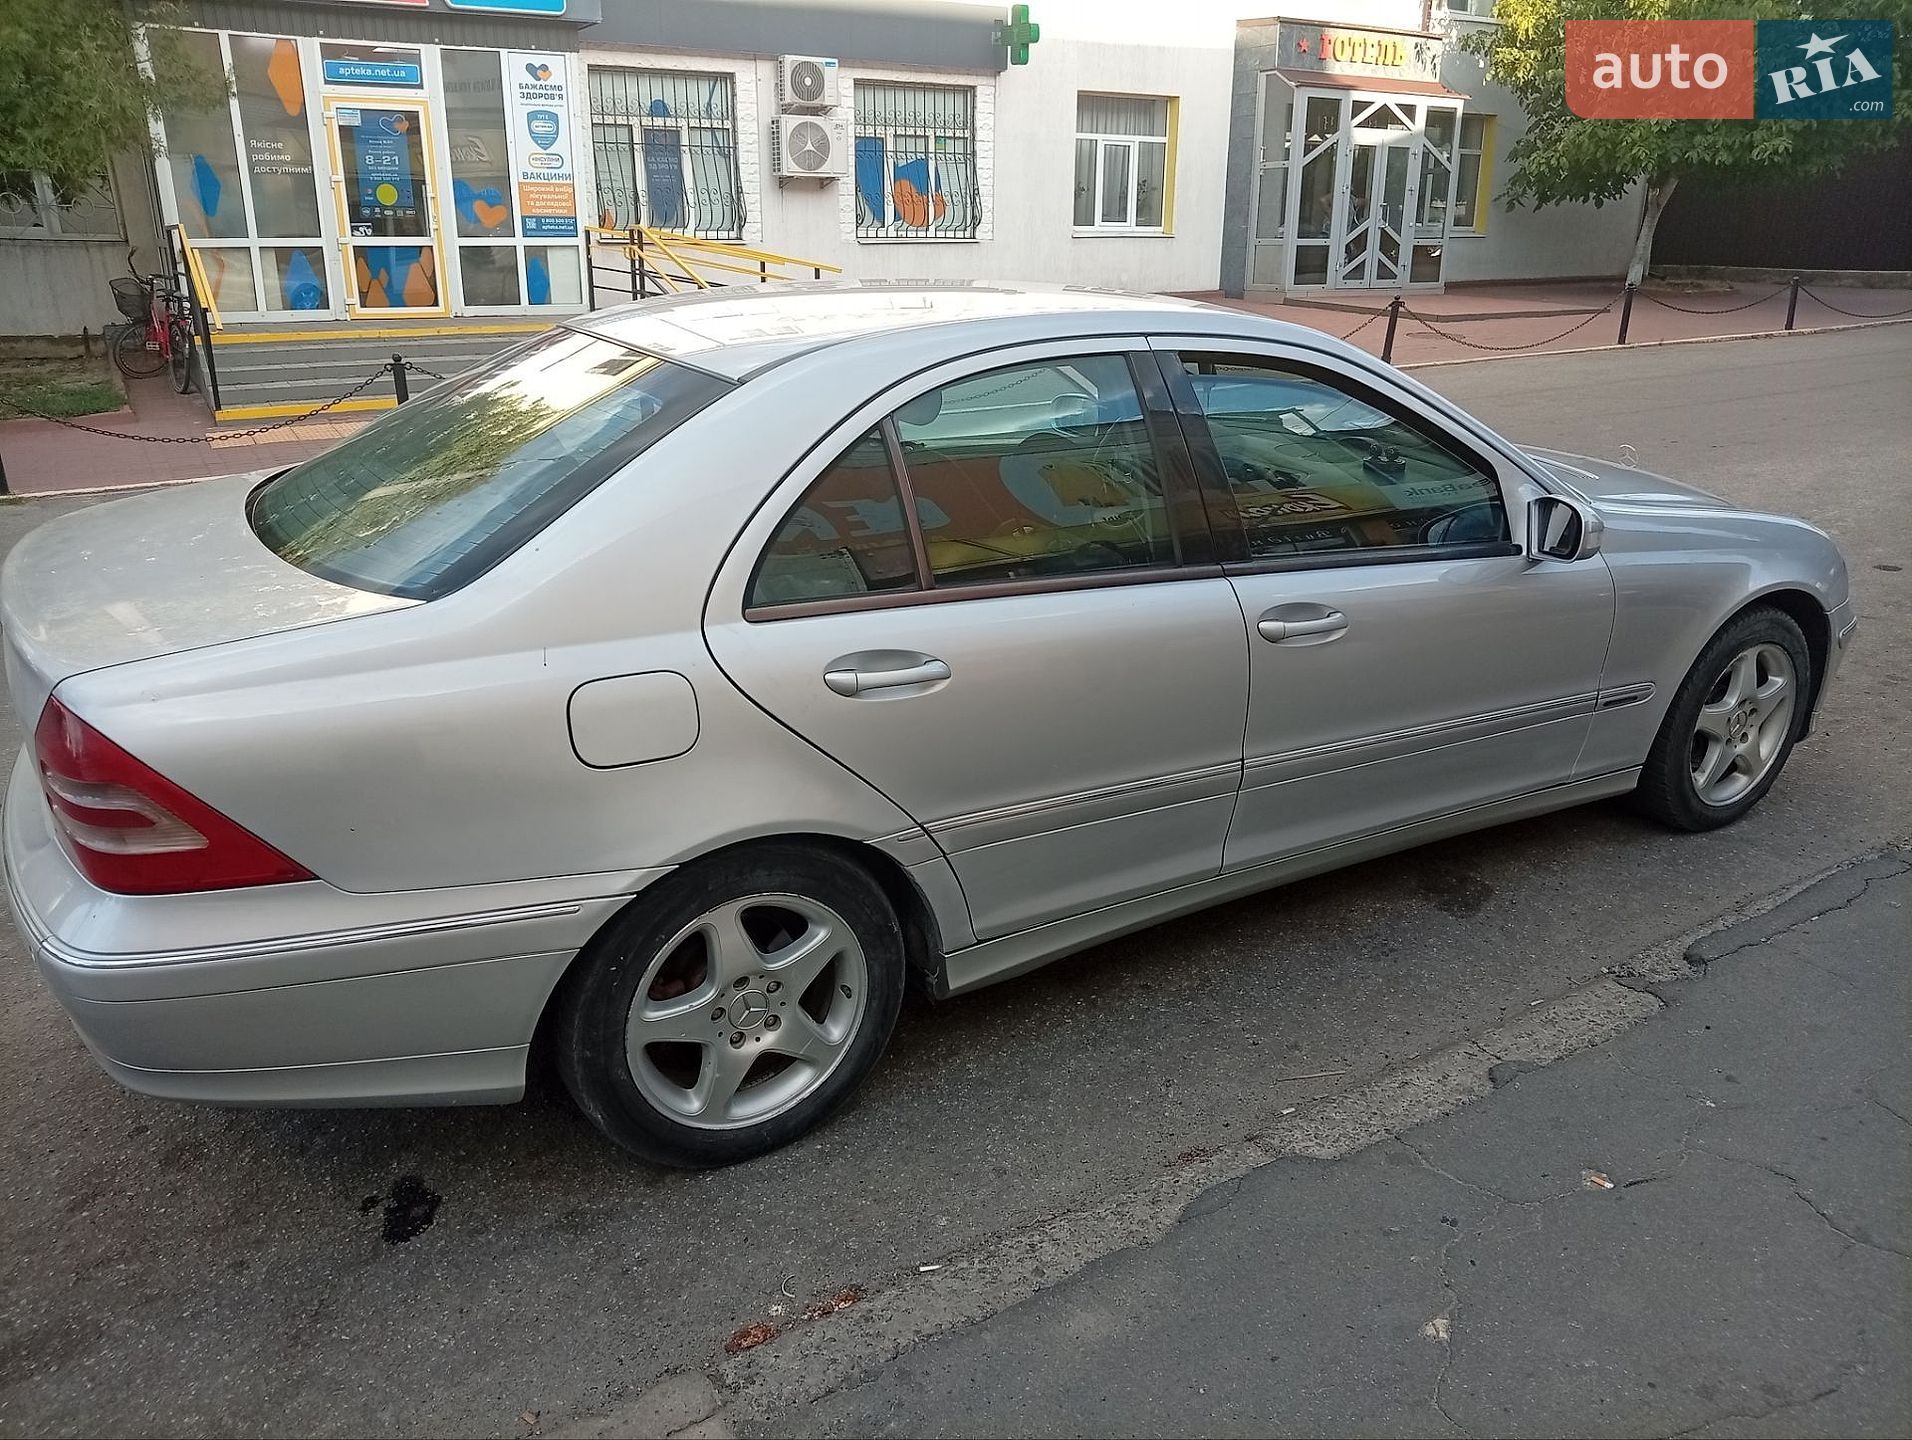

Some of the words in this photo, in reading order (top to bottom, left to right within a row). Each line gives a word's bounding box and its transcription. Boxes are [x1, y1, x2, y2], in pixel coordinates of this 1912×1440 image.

[1318, 33, 1407, 66] ГОТЕЛЬ
[338, 66, 406, 78] apteka.net.ua
[519, 92, 564, 101] ЗДОРОВ'Я
[250, 139, 284, 149] Якісне
[252, 152, 291, 162] робимо
[365, 155, 399, 165] 8-21
[254, 165, 312, 175] доступним!
[522, 171, 572, 181] ВАКЦИНИ
